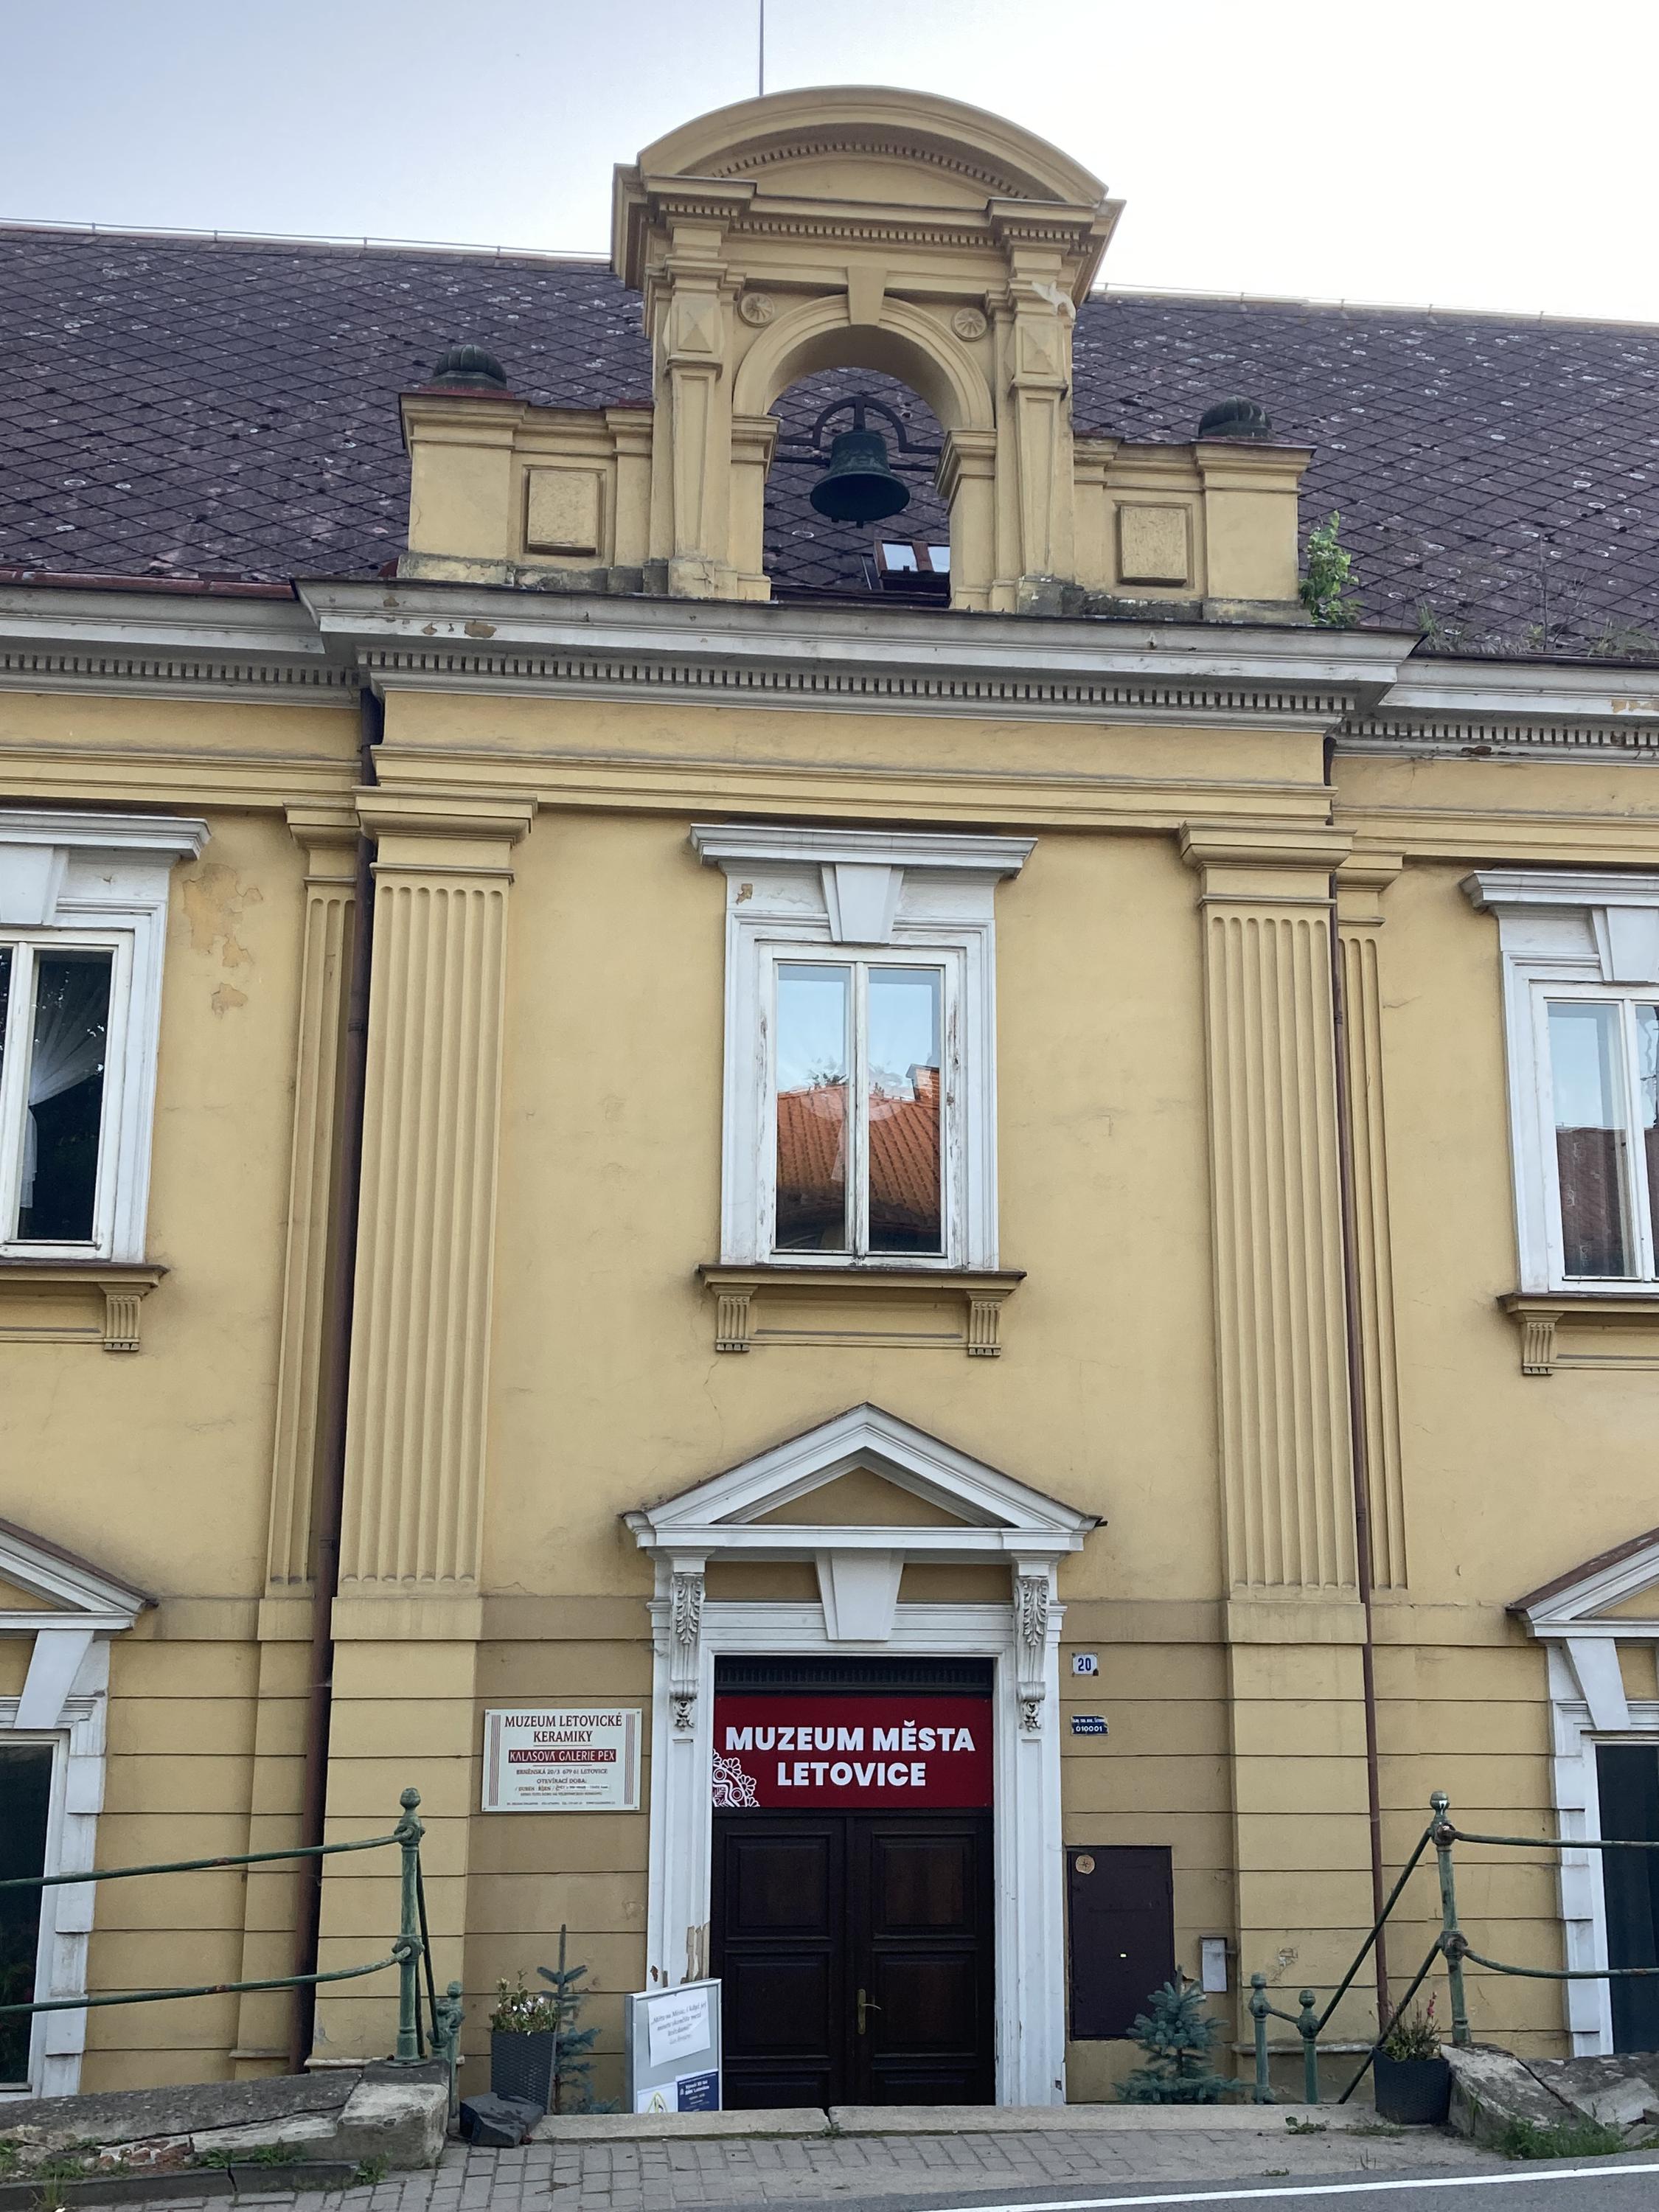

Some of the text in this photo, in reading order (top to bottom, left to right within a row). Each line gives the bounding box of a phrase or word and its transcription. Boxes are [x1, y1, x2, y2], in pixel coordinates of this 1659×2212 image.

[1077, 1658, 1091, 1671] 20
[504, 1712, 622, 1727] MUZEUM LETOVICKÉ
[533, 1731, 593, 1742] KERAMIKY
[726, 1720, 975, 1751] MUZEUM MĚSTA
[559, 1750, 596, 1761] GALERIE
[598, 1750, 615, 1761] PEX
[777, 1761, 926, 1786] LETOVICE
